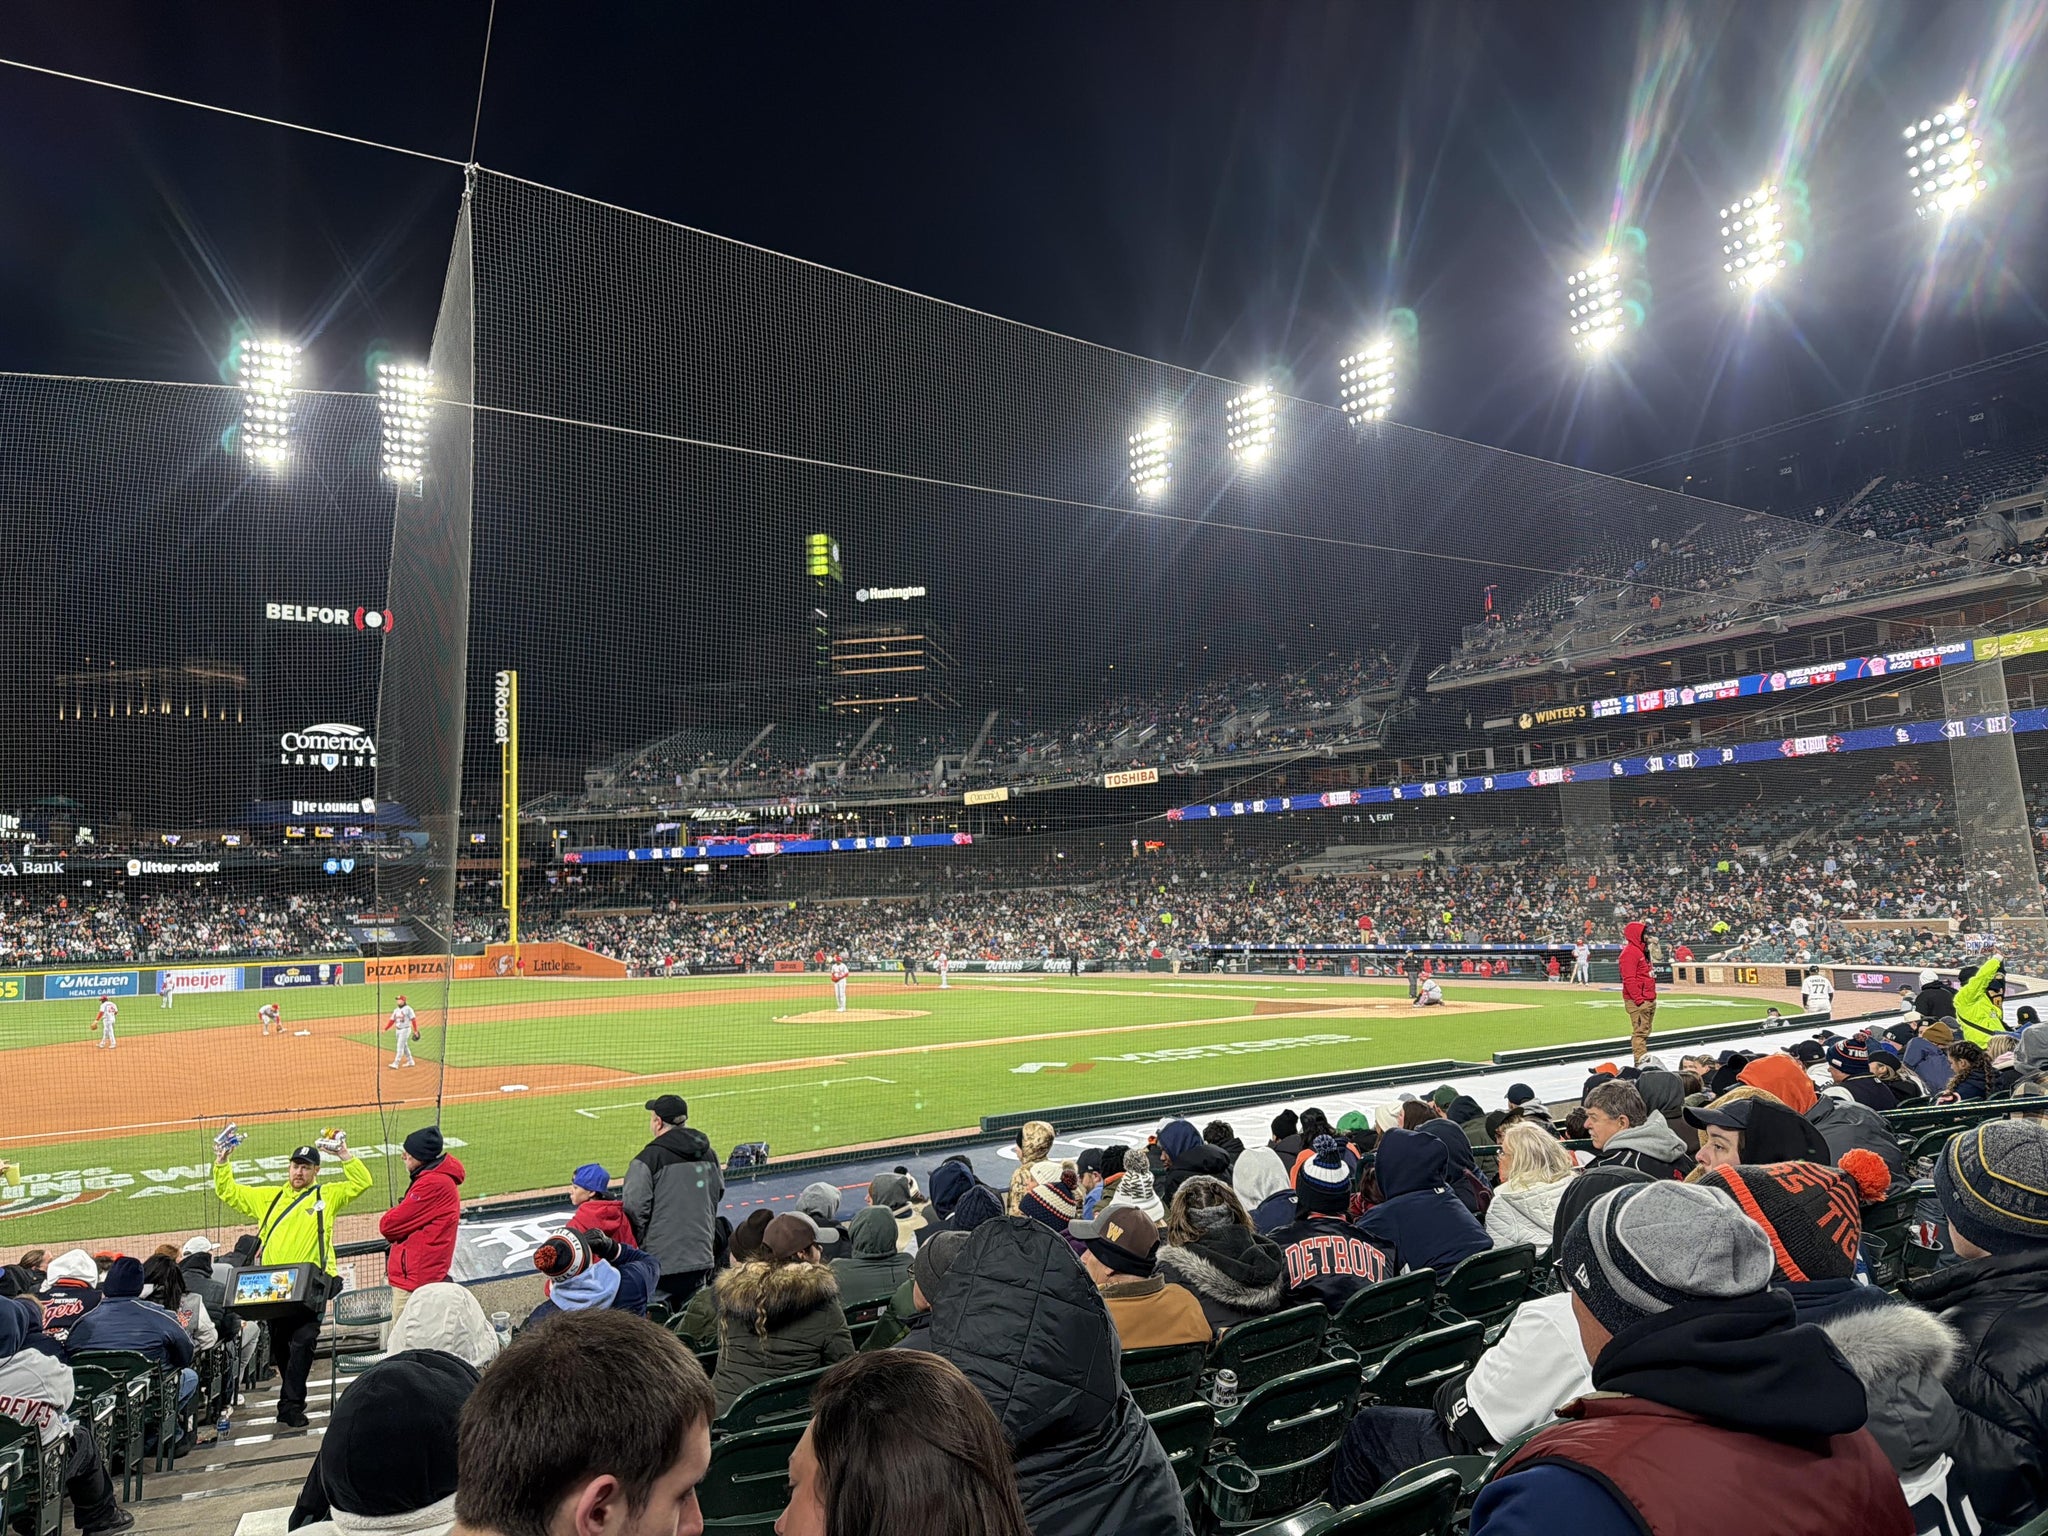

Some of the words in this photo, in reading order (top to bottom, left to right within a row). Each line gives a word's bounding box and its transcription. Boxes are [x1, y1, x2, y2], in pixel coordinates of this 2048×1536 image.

[870, 586, 925, 600] Huntington
[266, 603, 350, 625] BELFOR
[1886, 643, 1966, 662] TORKELSON
[1786, 663, 1846, 678] MEADOWS
[1890, 661, 1911, 670] #20
[1920, 658, 1936, 666] 1-1
[1694, 680, 1739, 693] DINGLER
[1789, 677, 1808, 685] #22
[1600, 698, 1621, 707] STL
[1625, 695, 1634, 704] 4
[1640, 692, 1660, 701] DUE
[1601, 706, 1621, 716] DET
[1626, 704, 1635, 713] 2
[1640, 699, 1660, 710] UP
[495, 687, 510, 744] Rocket
[1536, 705, 1586, 723] WINTER'S
[1948, 721, 1966, 738] STL
[1986, 717, 2007, 733] DET
[281, 753, 377, 770] LANDING
[1107, 770, 1156, 786] TOSHIBA
[318, 802, 359, 813] LOUNGE
[759, 806, 788, 817] TIGER
[1376, 814, 1394, 823] EXIT
[22, 861, 65, 874] Bank
[366, 964, 407, 977] PIZZA!
[408, 962, 448, 974] PIZZA!
[533, 959, 561, 972] Little
[75, 976, 129, 988] McLaren
[175, 971, 226, 989] meijer
[273, 973, 312, 986] Corona
[1812, 984, 1825, 994] 77
[1106, 1221, 1124, 1242] W
[1285, 1235, 1386, 1289] DETROIT
